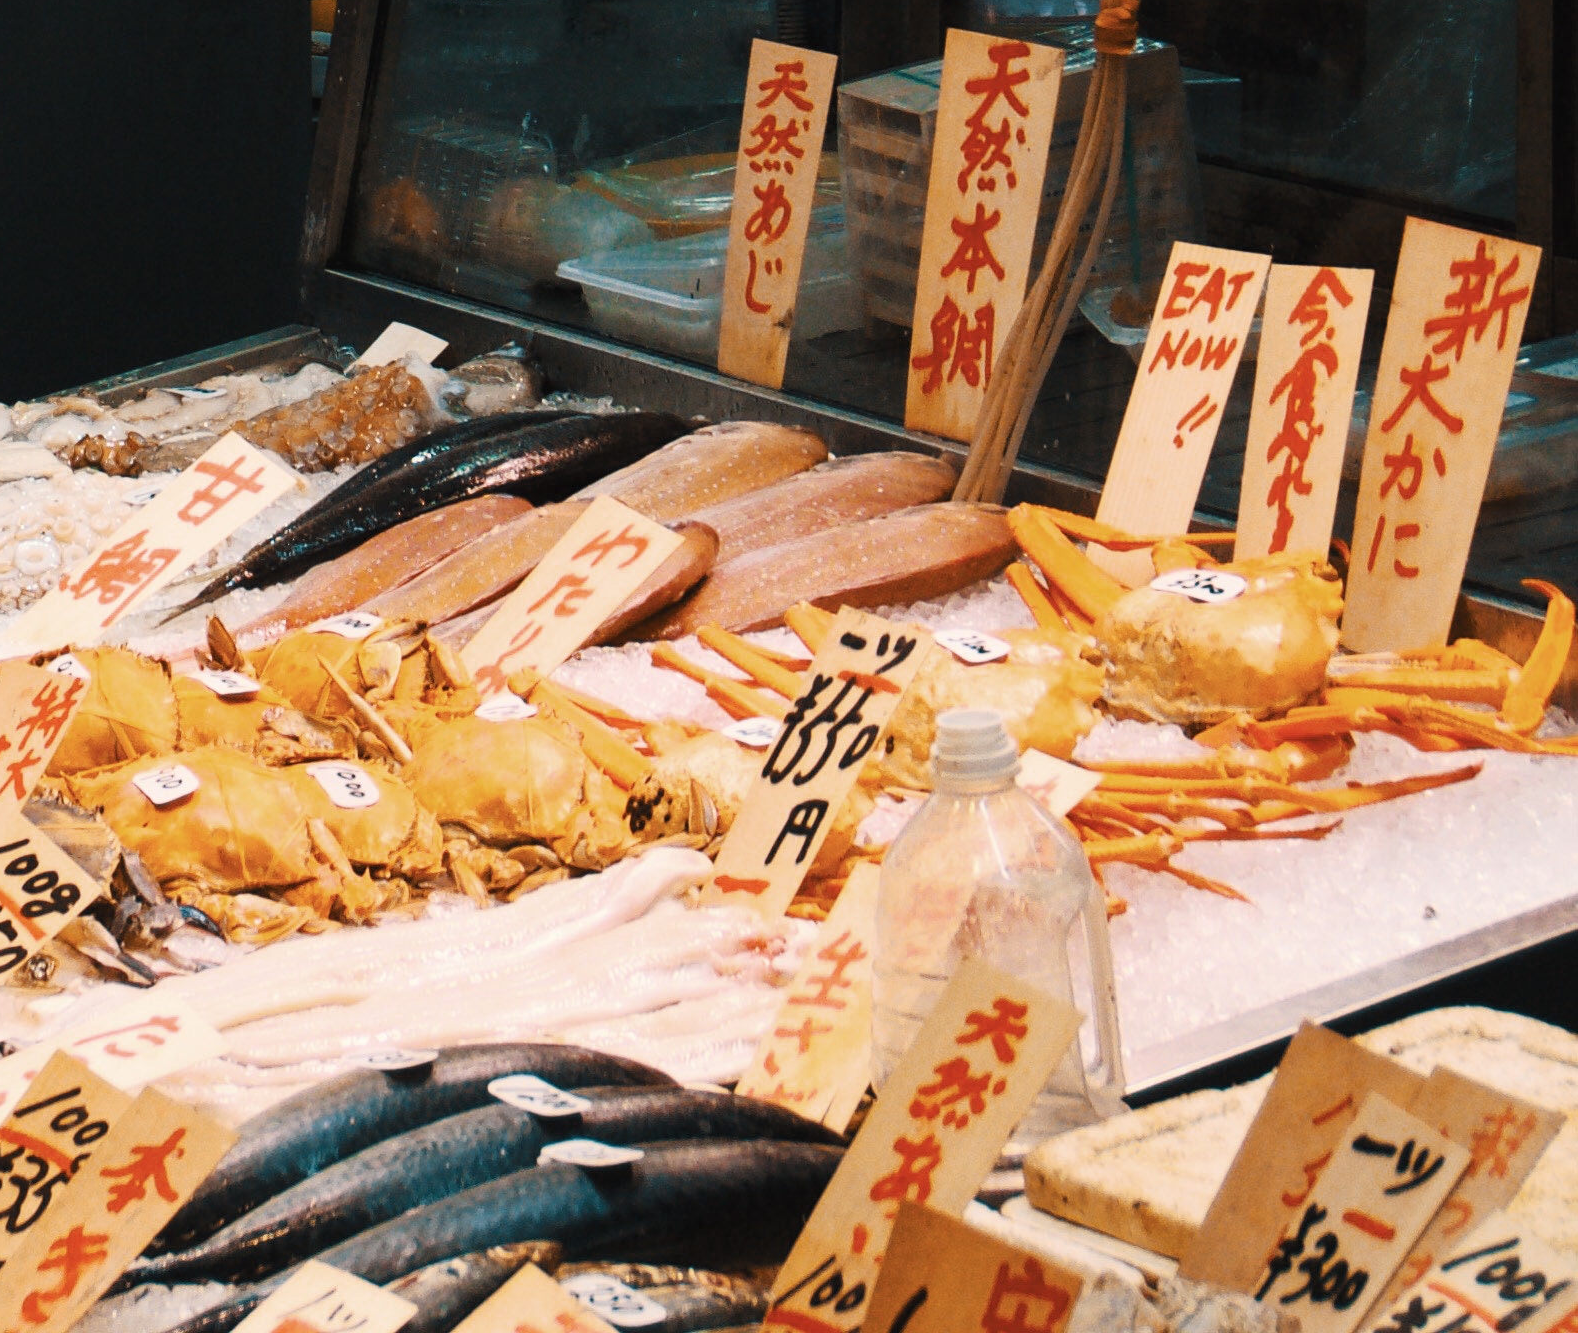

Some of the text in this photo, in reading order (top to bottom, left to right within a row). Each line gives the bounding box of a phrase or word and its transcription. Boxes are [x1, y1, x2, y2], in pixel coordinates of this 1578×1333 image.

[743, 60, 814, 314] 天然あじ
[911, 43, 1031, 396] 天然本鯛
[1161, 260, 1256, 321] EAT
[1148, 334, 1236, 375] NOW
[1367, 238, 1530, 580] 新大かに
[765, 799, 830, 865] 円
[1351, 1133, 1445, 1197] 一ツ
[1253, 1203, 1370, 1312] ¥300
